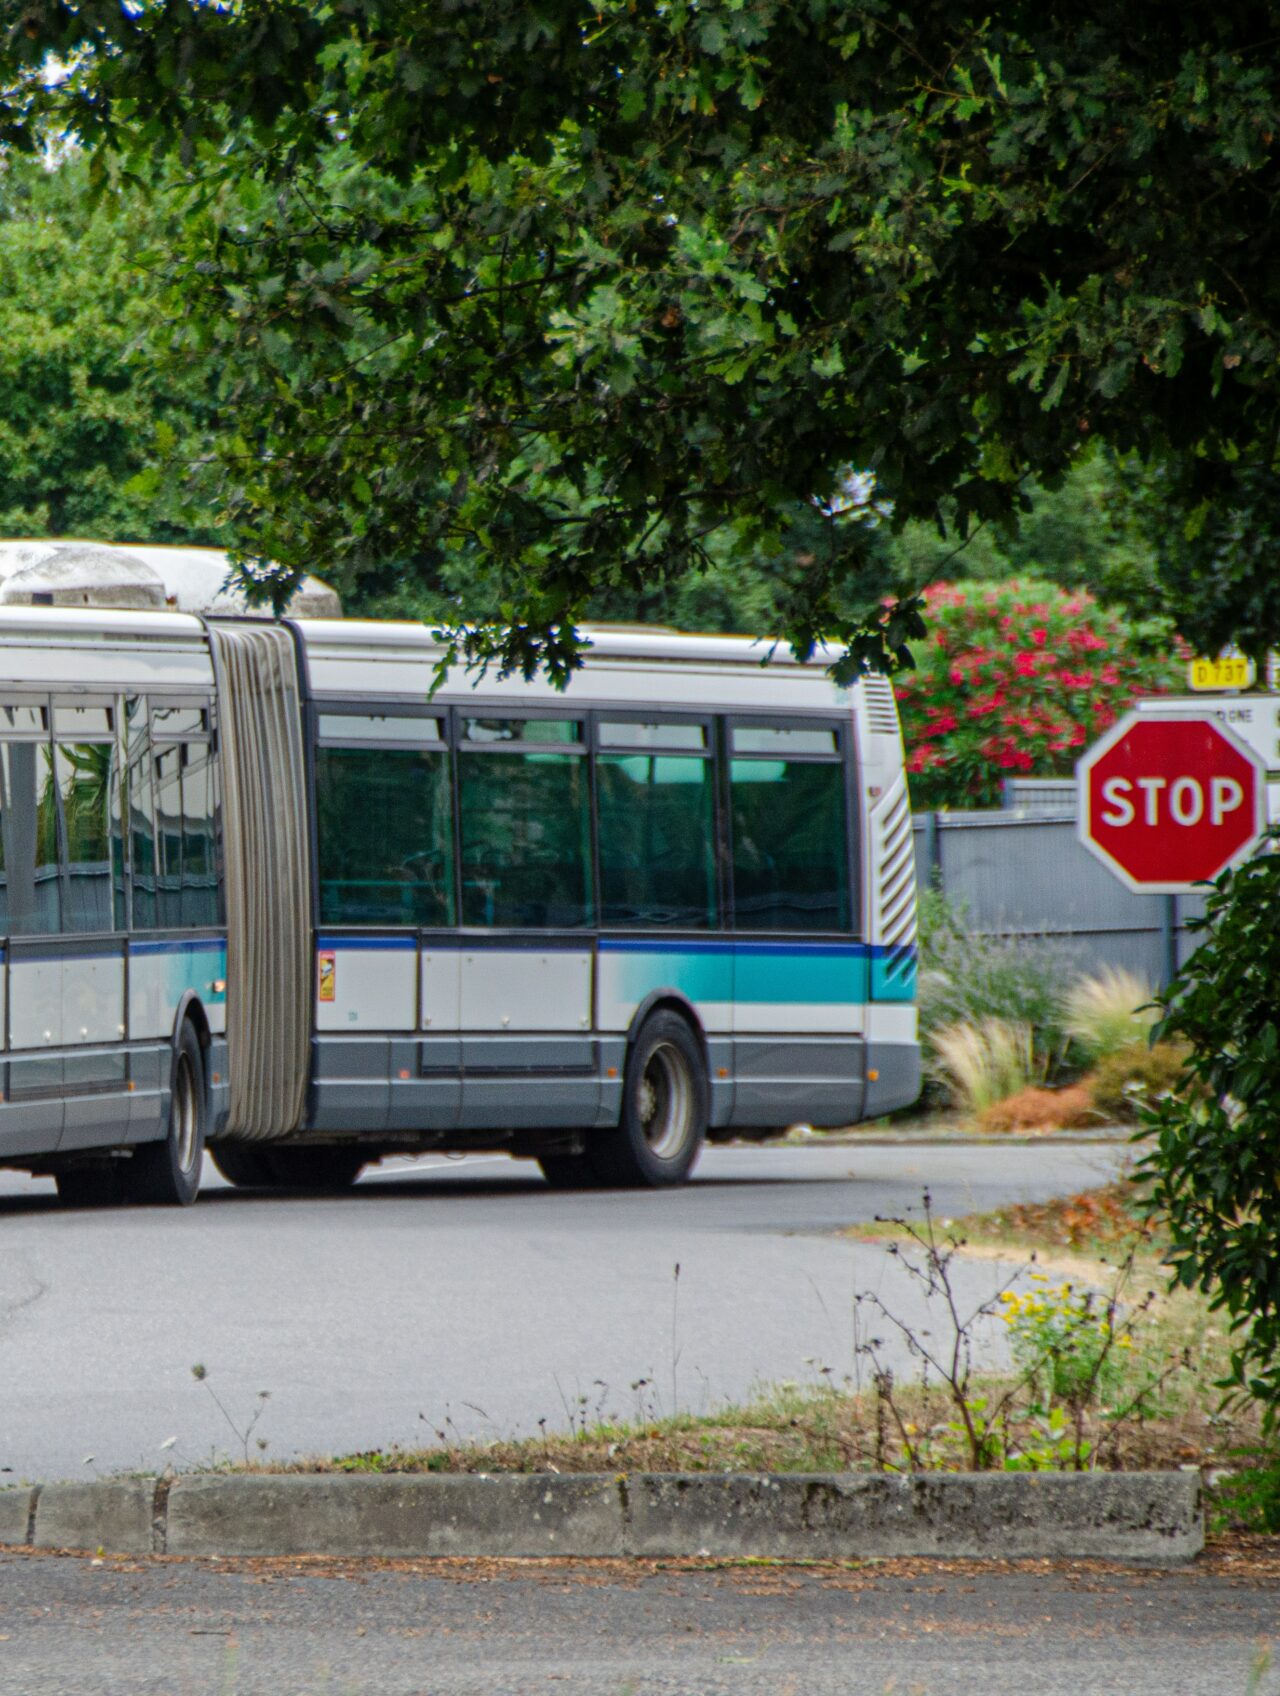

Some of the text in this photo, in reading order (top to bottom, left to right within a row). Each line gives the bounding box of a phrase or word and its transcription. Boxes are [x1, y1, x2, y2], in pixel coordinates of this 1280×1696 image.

[1197, 666, 1207, 683] D
[1213, 664, 1245, 682] 737
[1101, 776, 1244, 827] STOP
